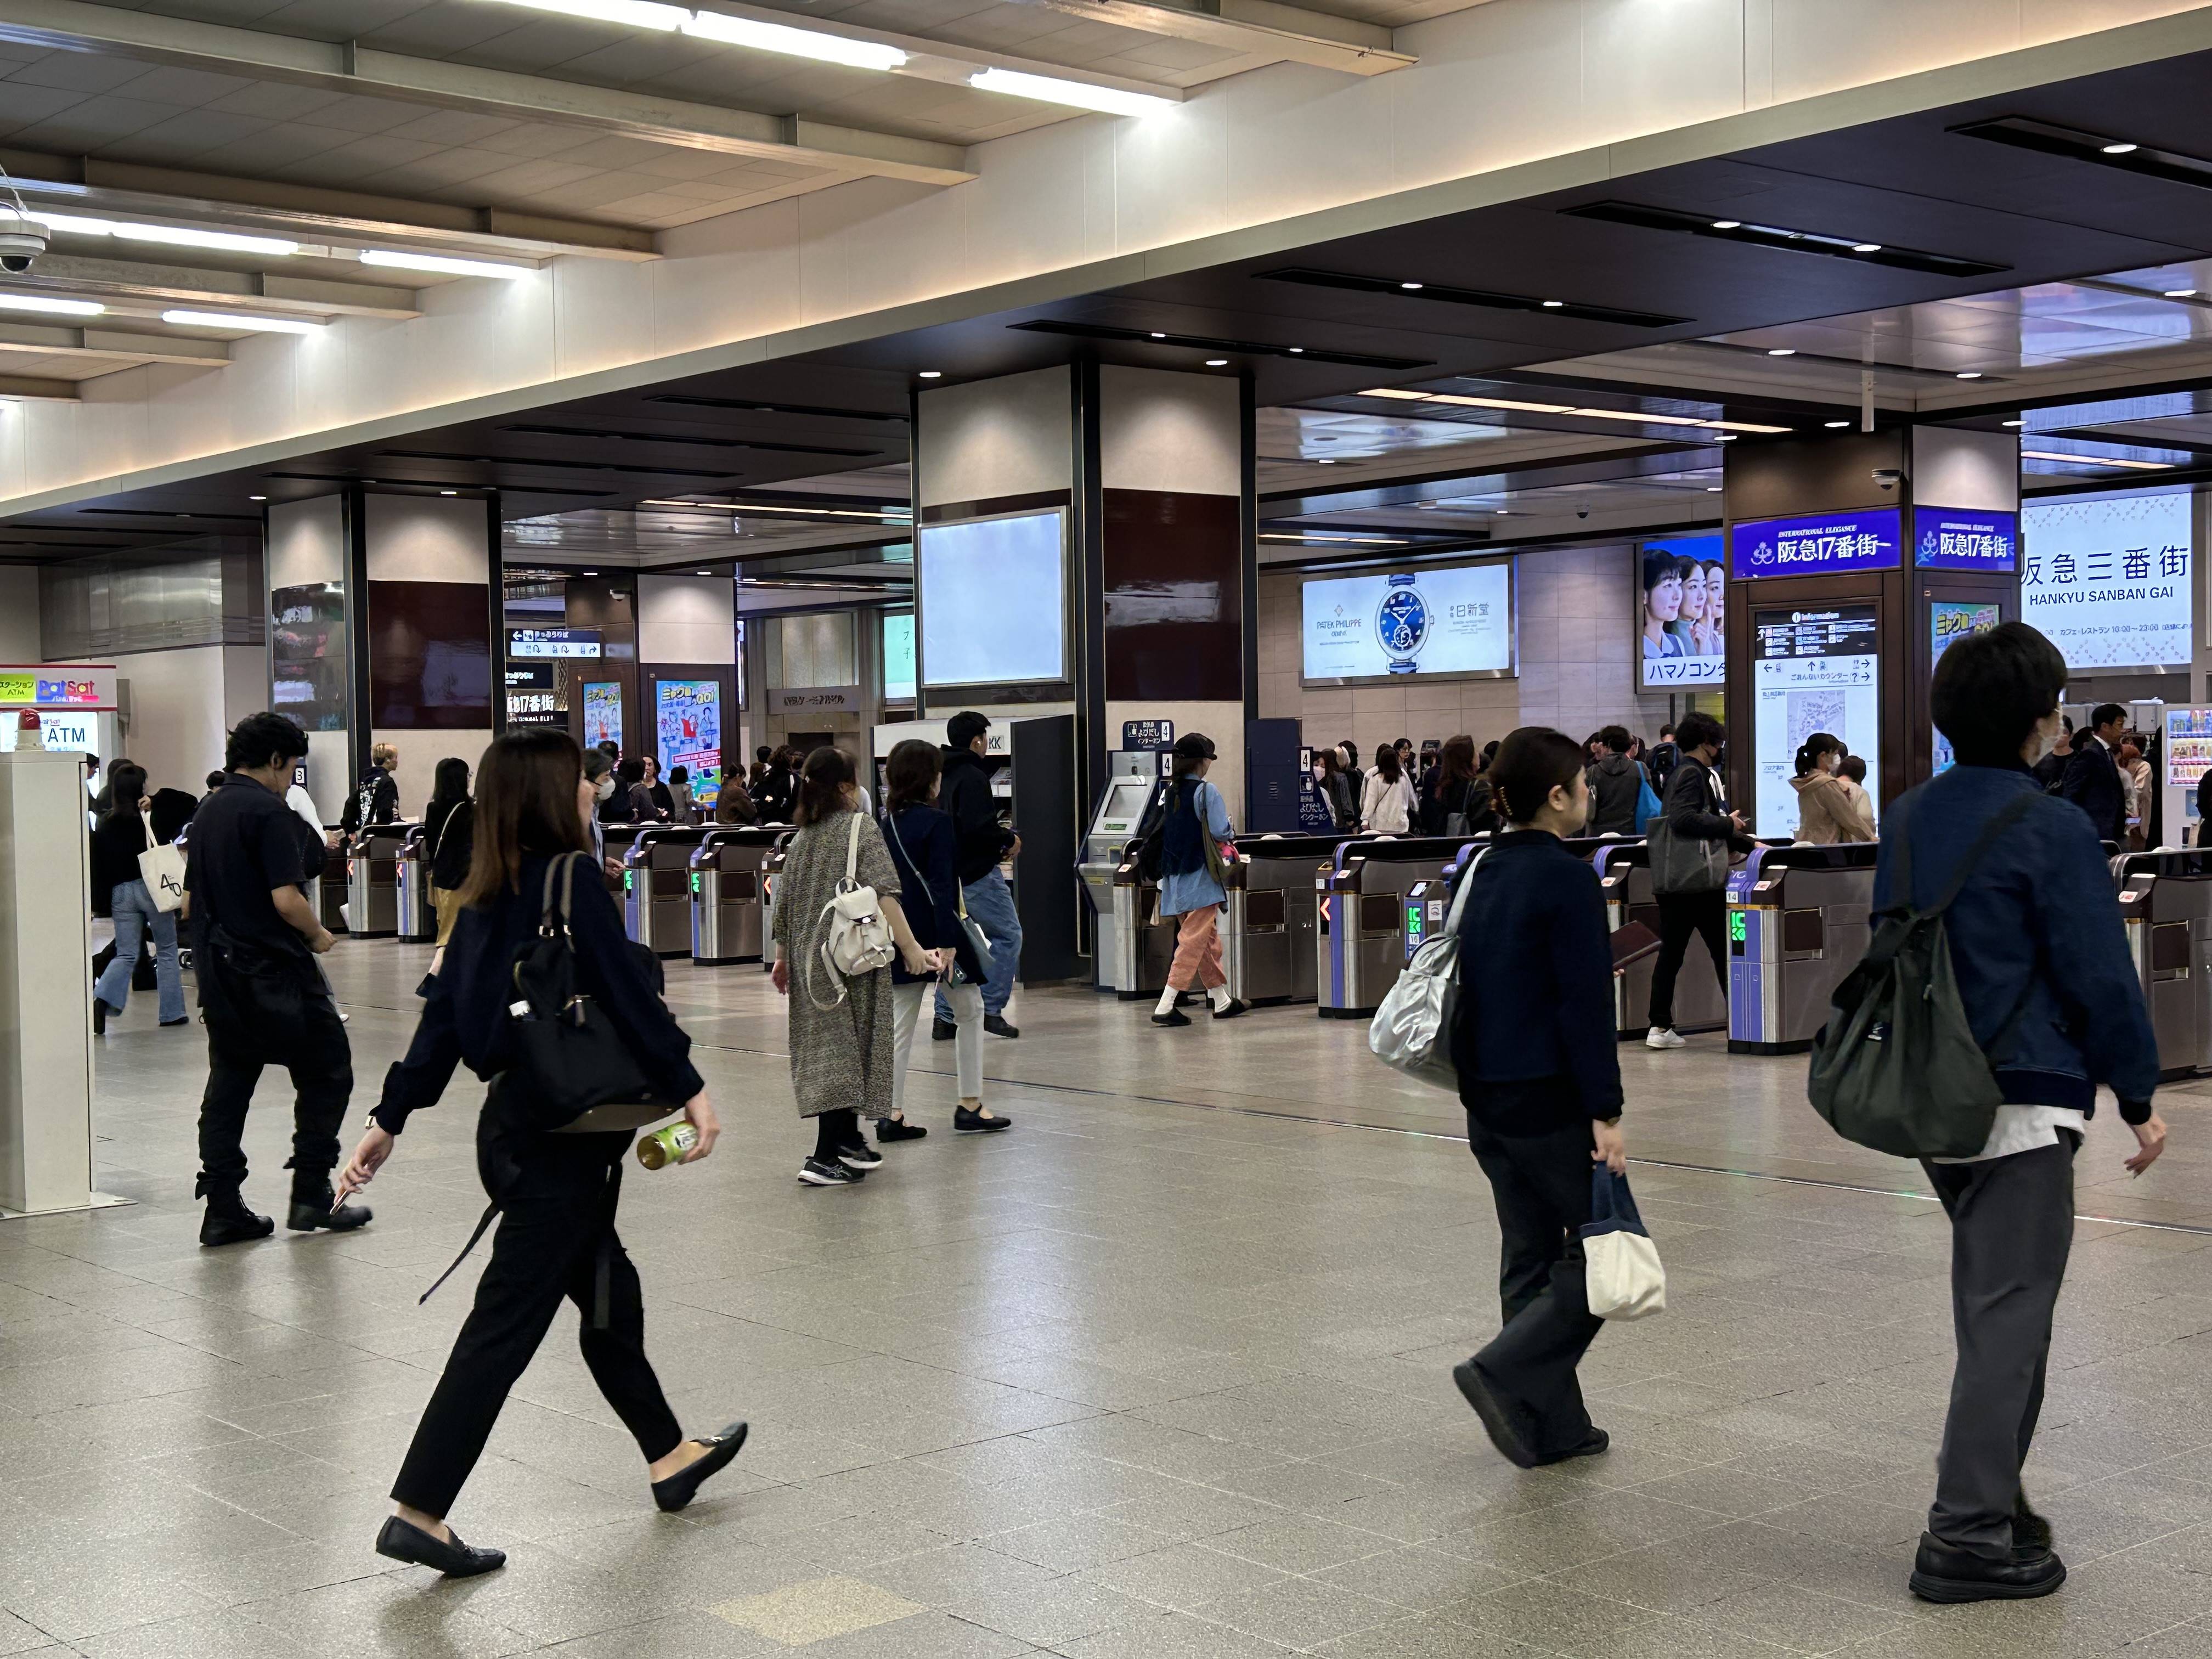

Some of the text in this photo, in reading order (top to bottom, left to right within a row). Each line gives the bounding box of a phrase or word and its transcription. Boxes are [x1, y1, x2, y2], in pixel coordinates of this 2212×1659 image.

[1778, 533, 1880, 563] 阪急17番街
[1940, 532, 2007, 557] 阪急17番街
[2030, 586, 2174, 606] HANKYU SANBAN GAI
[1336, 619, 1362, 628] PHILIPPE
[48, 728, 85, 742] ATM
[1163, 725, 1168, 738] 4
[1164, 758, 1170, 772] 4
[1302, 754, 1308, 768] 4
[297, 771, 303, 781] 3
[1408, 907, 1421, 922] IC
[1731, 912, 1746, 928] IC
